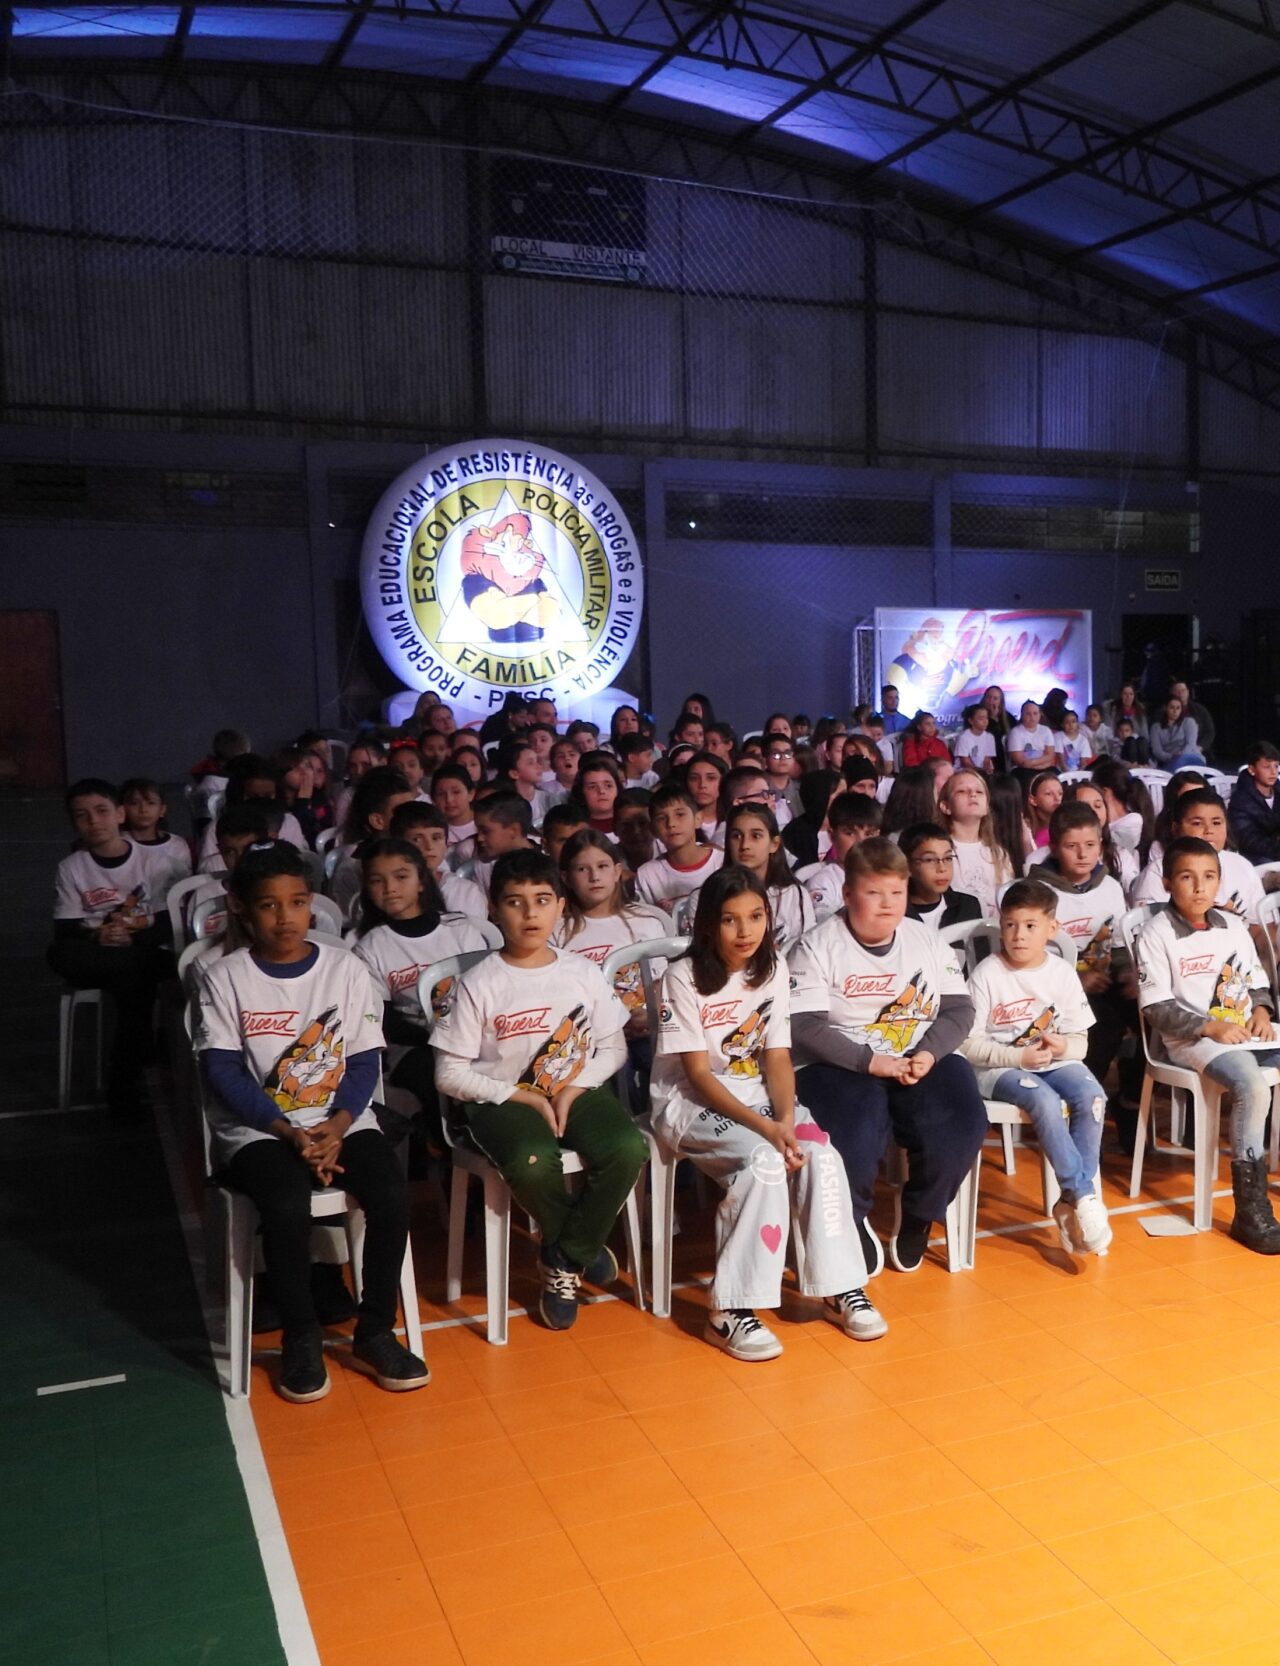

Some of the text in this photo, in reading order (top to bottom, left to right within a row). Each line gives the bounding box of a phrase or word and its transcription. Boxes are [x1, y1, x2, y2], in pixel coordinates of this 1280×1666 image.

[499, 238, 641, 264] LOCAL VISITANTE
[430, 463, 457, 489] DE
[457, 451, 574, 492] RESISTÊNCIA
[379, 482, 436, 606] EDUCACIONAL
[412, 494, 480, 604] ESCOLA
[522, 488, 605, 630] POLÍCIA MILITAR
[591, 501, 635, 572] DROGAS
[386, 609, 465, 698] PROGRAMA
[456, 647, 576, 684] FAMÍLIA
[572, 610, 634, 690] VIOLÊNCIA
[842, 974, 895, 995] Proerd
[493, 1010, 550, 1038] Proerd
[818, 1152, 843, 1237] FASHION
